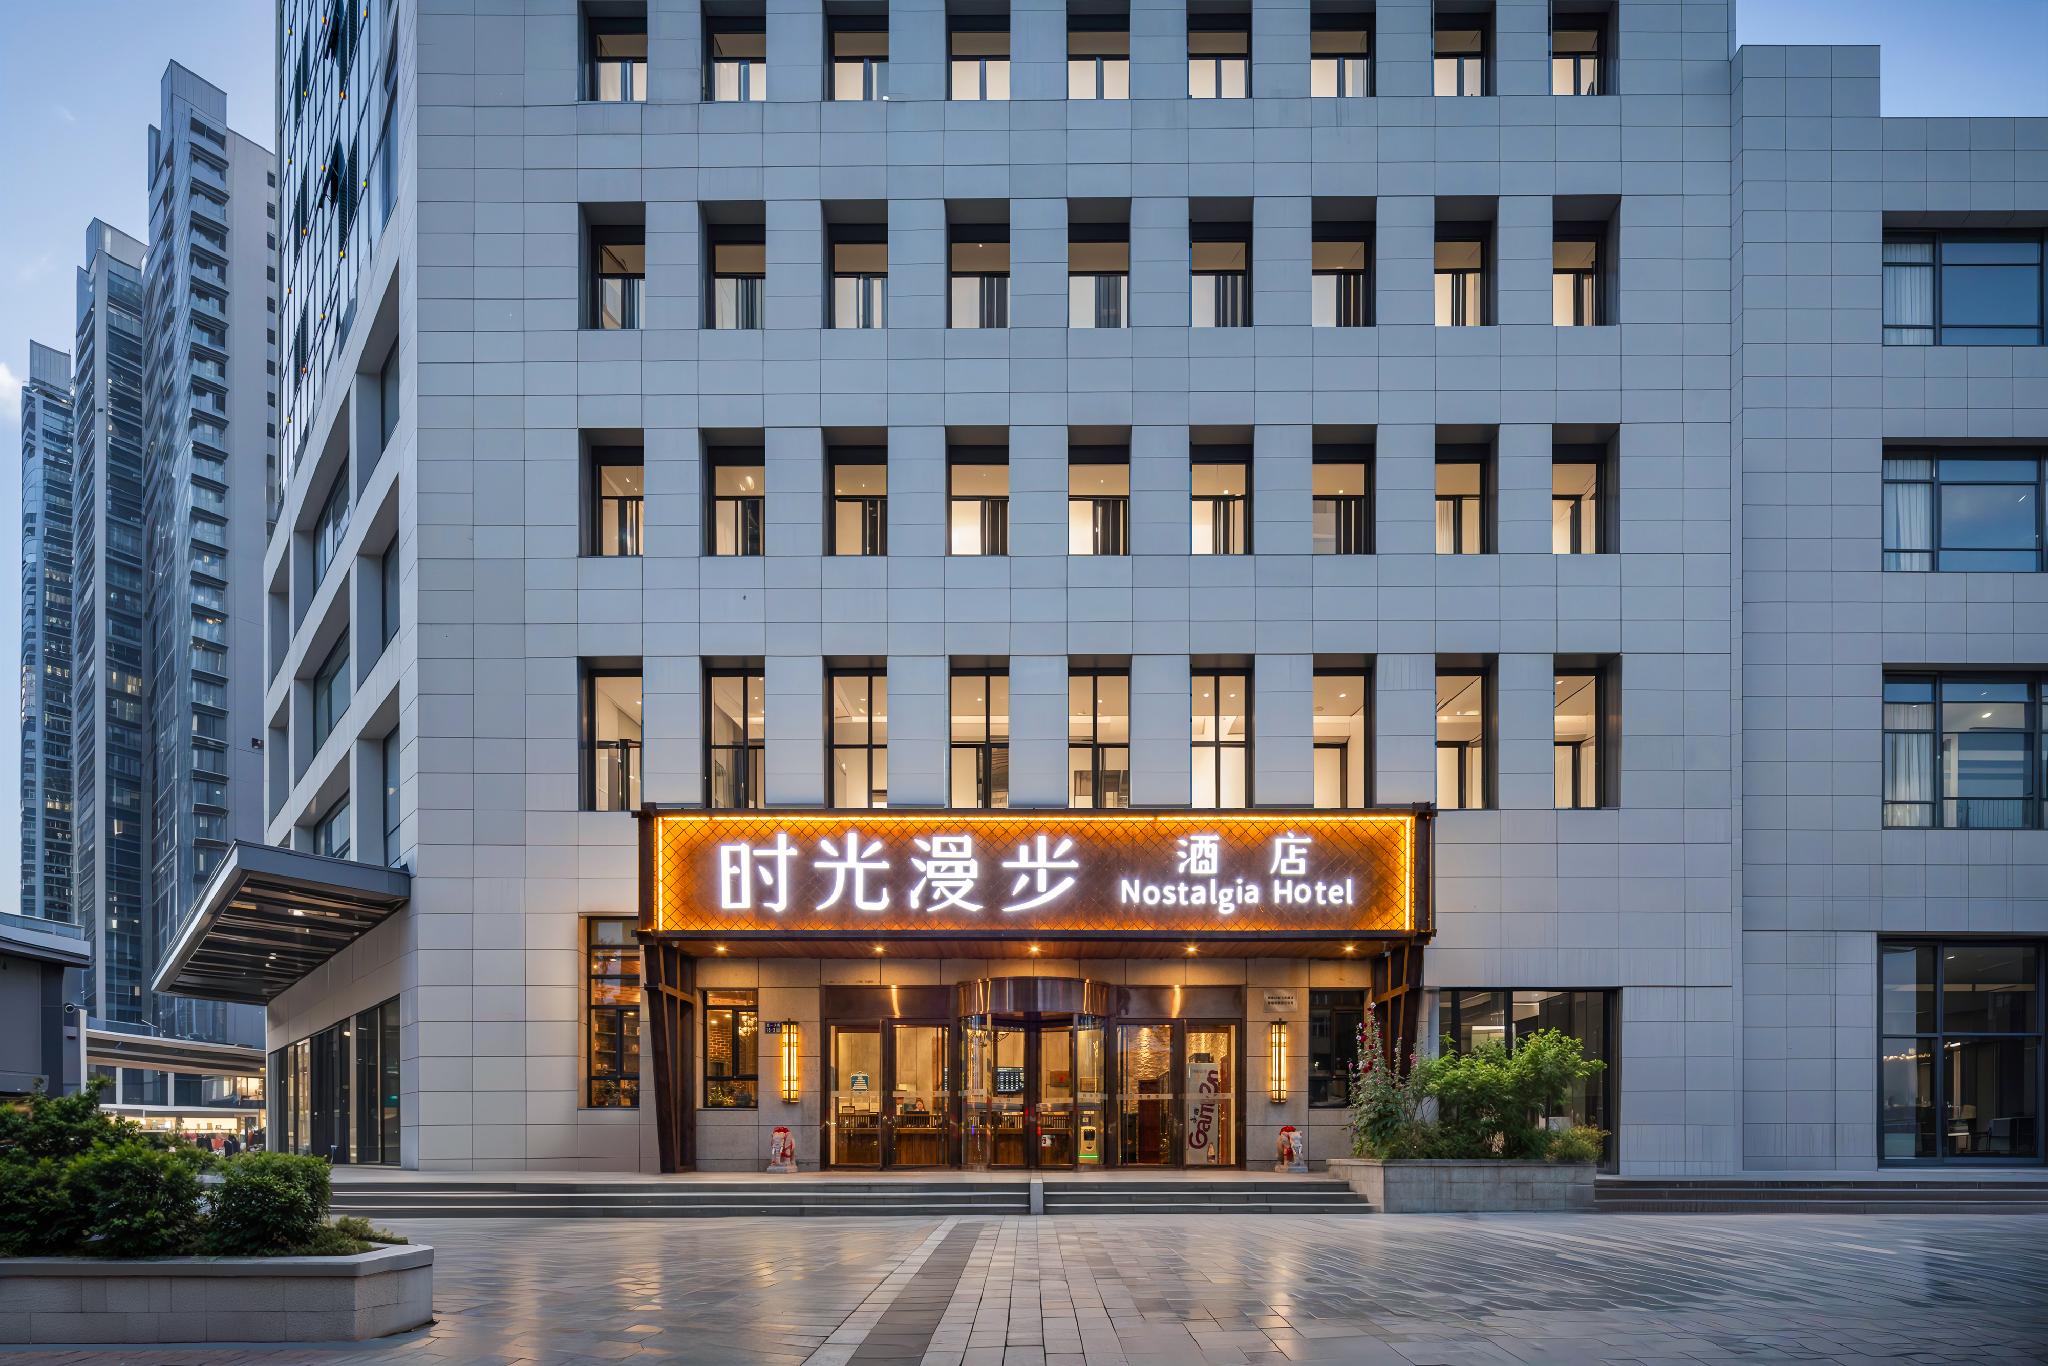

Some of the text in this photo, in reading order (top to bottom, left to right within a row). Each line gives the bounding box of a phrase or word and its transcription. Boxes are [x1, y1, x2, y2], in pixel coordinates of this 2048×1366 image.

[719, 831, 1080, 913] 时光漫步
[1175, 831, 1312, 875] 酒店
[1121, 878, 1353, 915] Nostalgia Hotel
